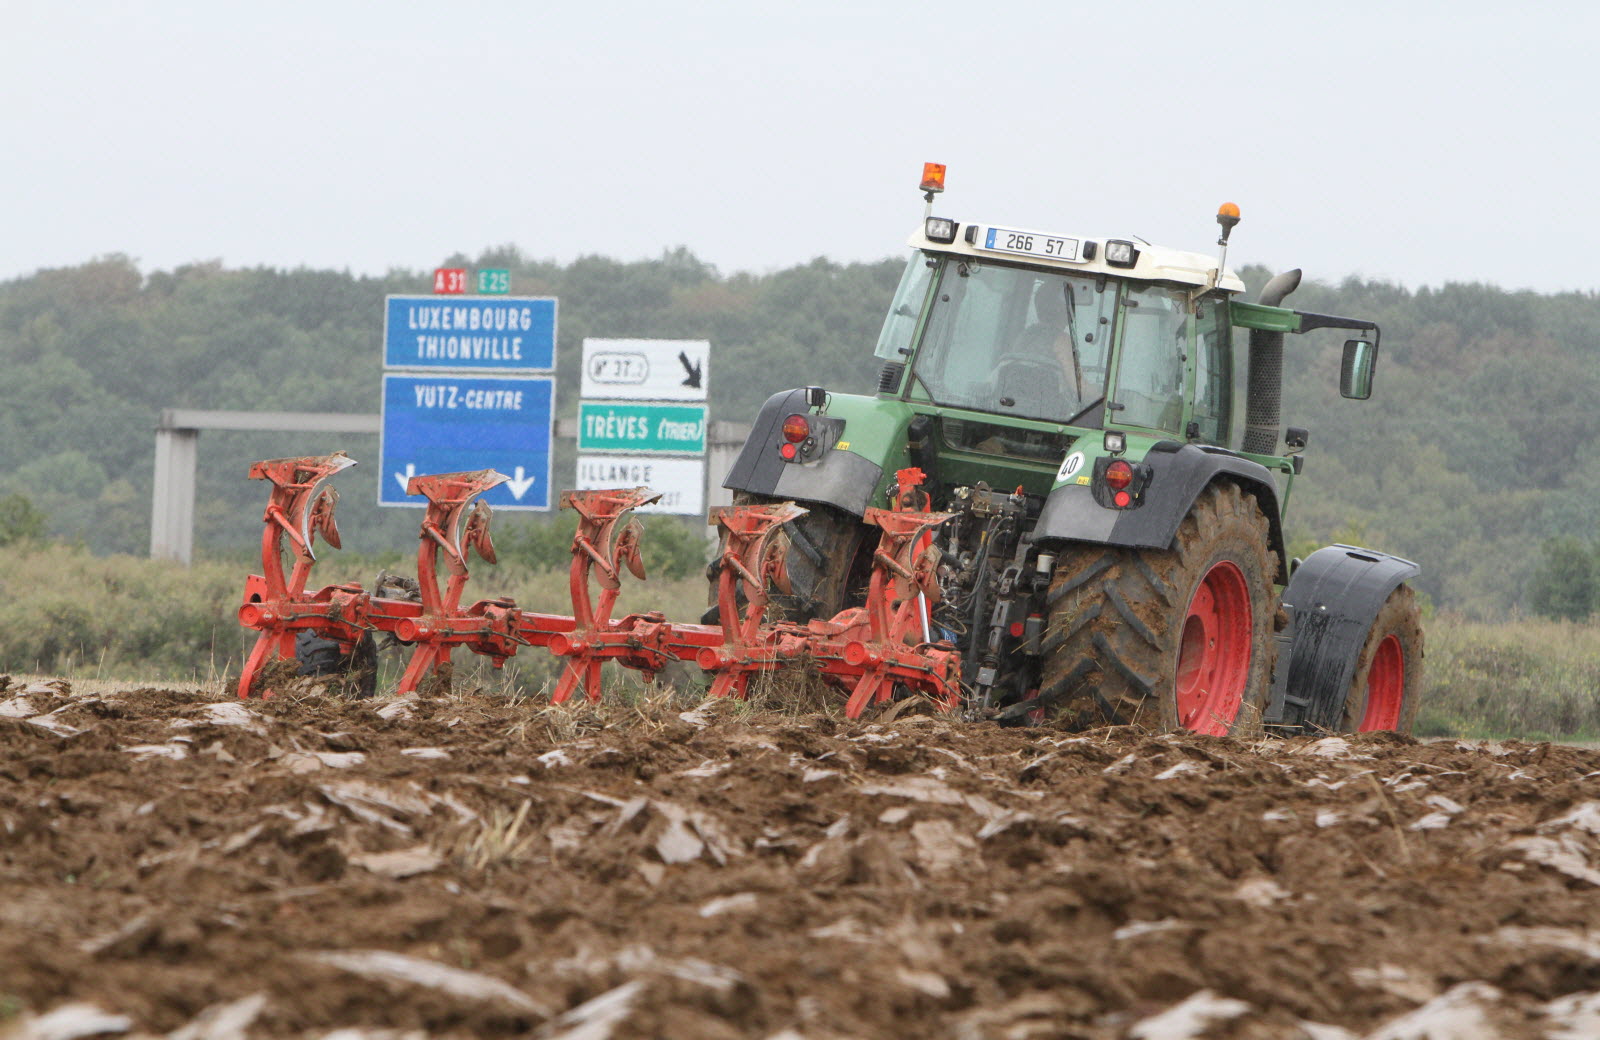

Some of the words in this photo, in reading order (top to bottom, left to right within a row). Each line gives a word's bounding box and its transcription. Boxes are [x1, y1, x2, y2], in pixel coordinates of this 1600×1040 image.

[1006, 233, 1034, 251] 266
[1045, 238, 1065, 255] 57
[434, 271, 445, 291] A
[447, 271, 465, 291] 31
[480, 270, 488, 291] E
[490, 271, 509, 292] 25
[408, 305, 533, 331] LUXEMBOURG
[416, 334, 524, 361] THIONVILLE
[414, 384, 524, 411] YUTZ-CENTRE
[581, 463, 653, 484] ILLANGE
[1060, 455, 1080, 476] 40
